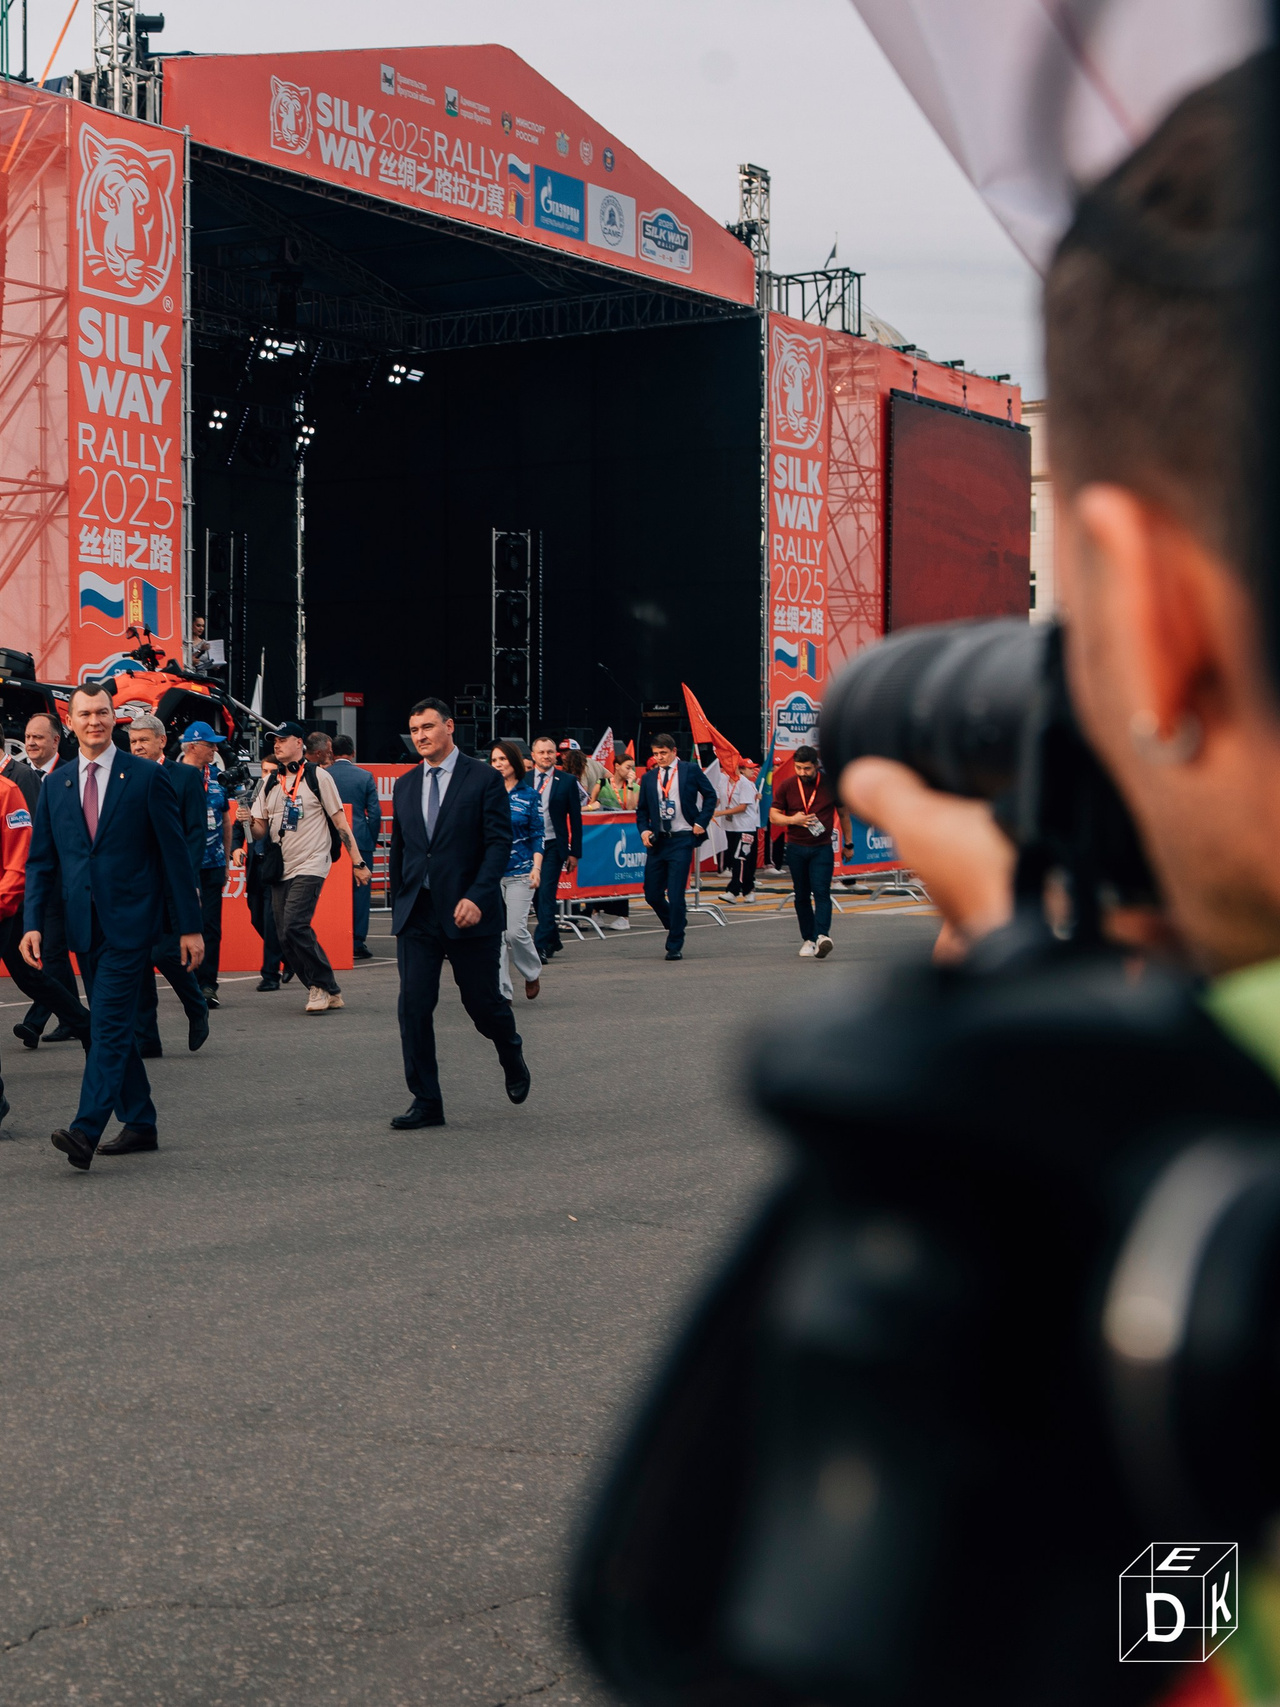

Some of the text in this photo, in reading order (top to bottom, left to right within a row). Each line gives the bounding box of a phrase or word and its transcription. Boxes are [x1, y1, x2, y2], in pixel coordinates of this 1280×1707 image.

[316, 92, 504, 182] SILK 2025 RALLY
[515, 117, 545, 135] МИНСПОРТ
[515, 130, 539, 145] РОССИИ
[317, 128, 376, 177] WAY
[378, 149, 505, 219] 丝绸之路拉力赛
[645, 225, 687, 246] SILK WAY
[658, 218, 674, 230] 2025
[78, 306, 172, 374] SILK
[78, 361, 172, 425] WAY
[78, 422, 172, 473] RALLY
[774, 453, 823, 496] SILK
[78, 465, 174, 530] 2025
[774, 492, 823, 532] WAY
[78, 524, 173, 574] 丝绸之路
[774, 533, 823, 566] RALLY
[774, 563, 825, 606] 2025
[773, 604, 824, 636] 丝绸之路
[779, 712, 819, 725] SILK WAY
